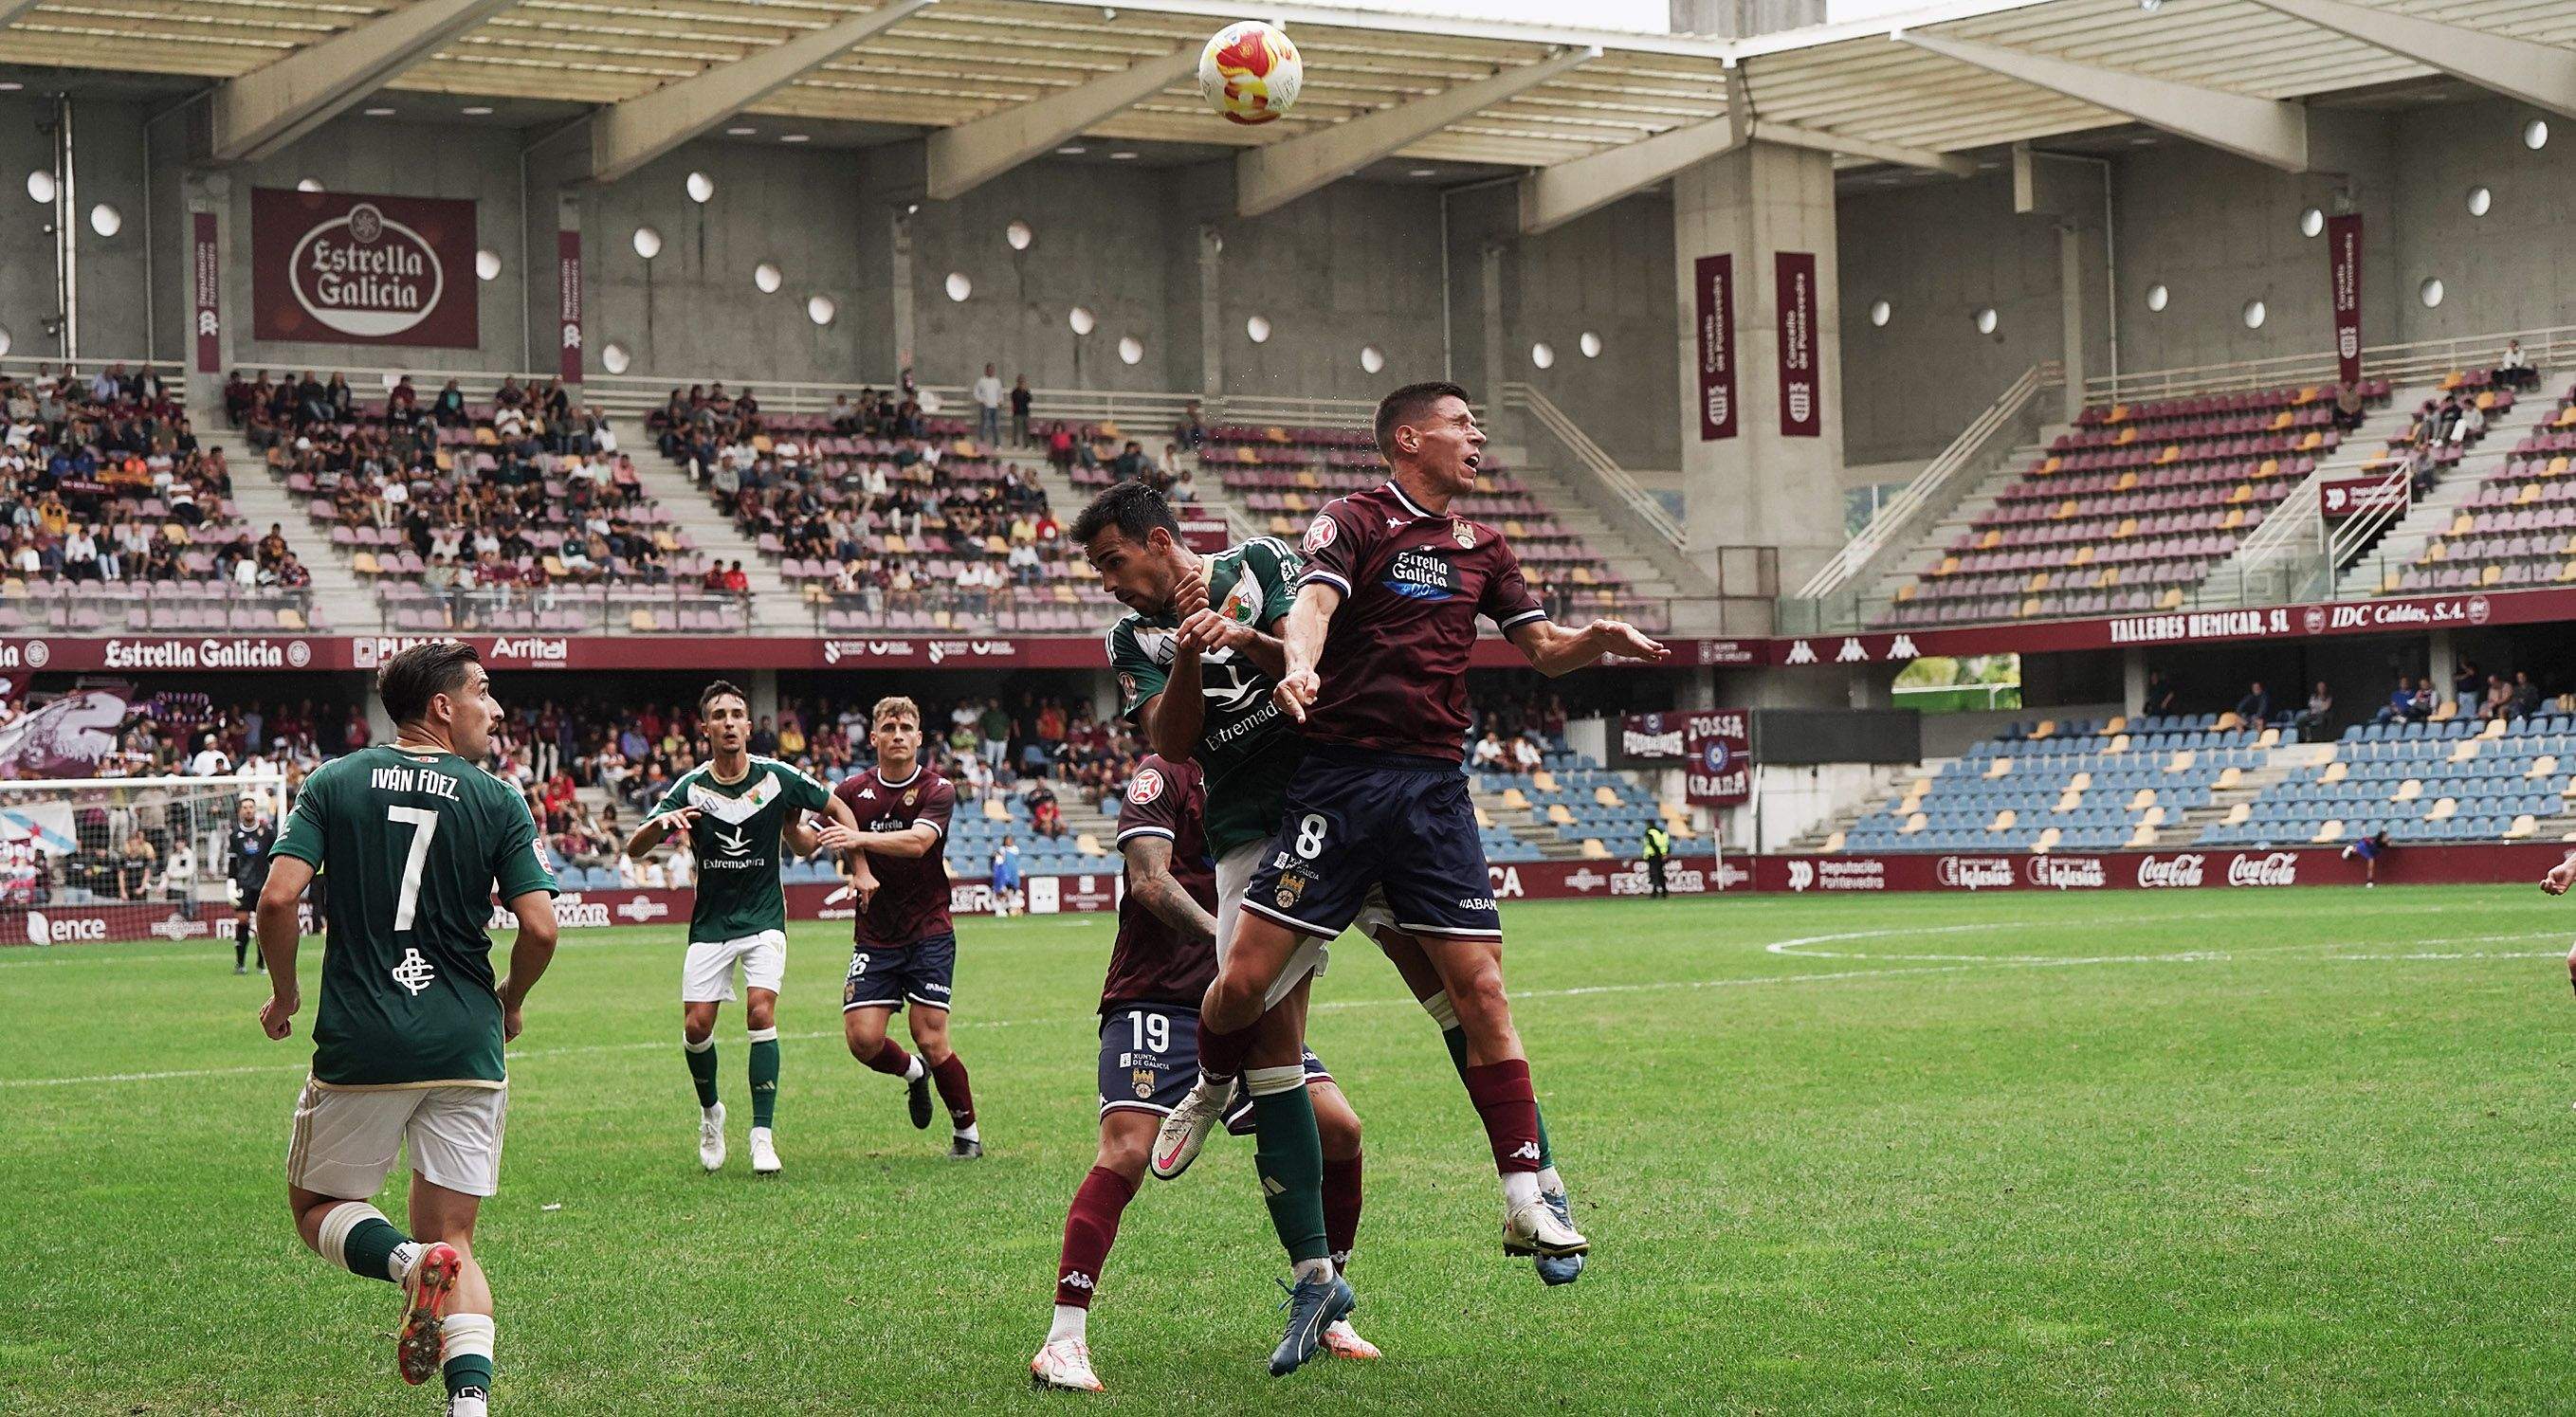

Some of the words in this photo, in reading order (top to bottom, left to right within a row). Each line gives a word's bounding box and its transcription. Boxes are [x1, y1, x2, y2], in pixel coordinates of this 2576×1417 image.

[313, 240, 423, 276] Estrella
[318, 272, 417, 308] Galicia
[1393, 562, 1448, 588] Galicia
[2330, 605, 2371, 628] IDC
[0, 639, 19, 667] ia
[104, 639, 195, 667] Estrella
[199, 639, 283, 667] Galicia
[491, 637, 568, 660] Arrital
[1205, 699, 1282, 752] Extremad
[372, 765, 412, 792] IVÁN
[417, 770, 460, 801] FDEZ.
[1296, 814, 1327, 860] 8
[388, 805, 439, 932] 7
[1819, 859, 1885, 876] Deputación
[1489, 866, 1524, 898] CA
[1819, 875, 1885, 889] Pontevedra
[50, 918, 106, 940] ence
[1128, 1010, 1171, 1053] 19
[1133, 1053, 1157, 1062] XUNTA
[1143, 1061, 1170, 1070] GALICIA
